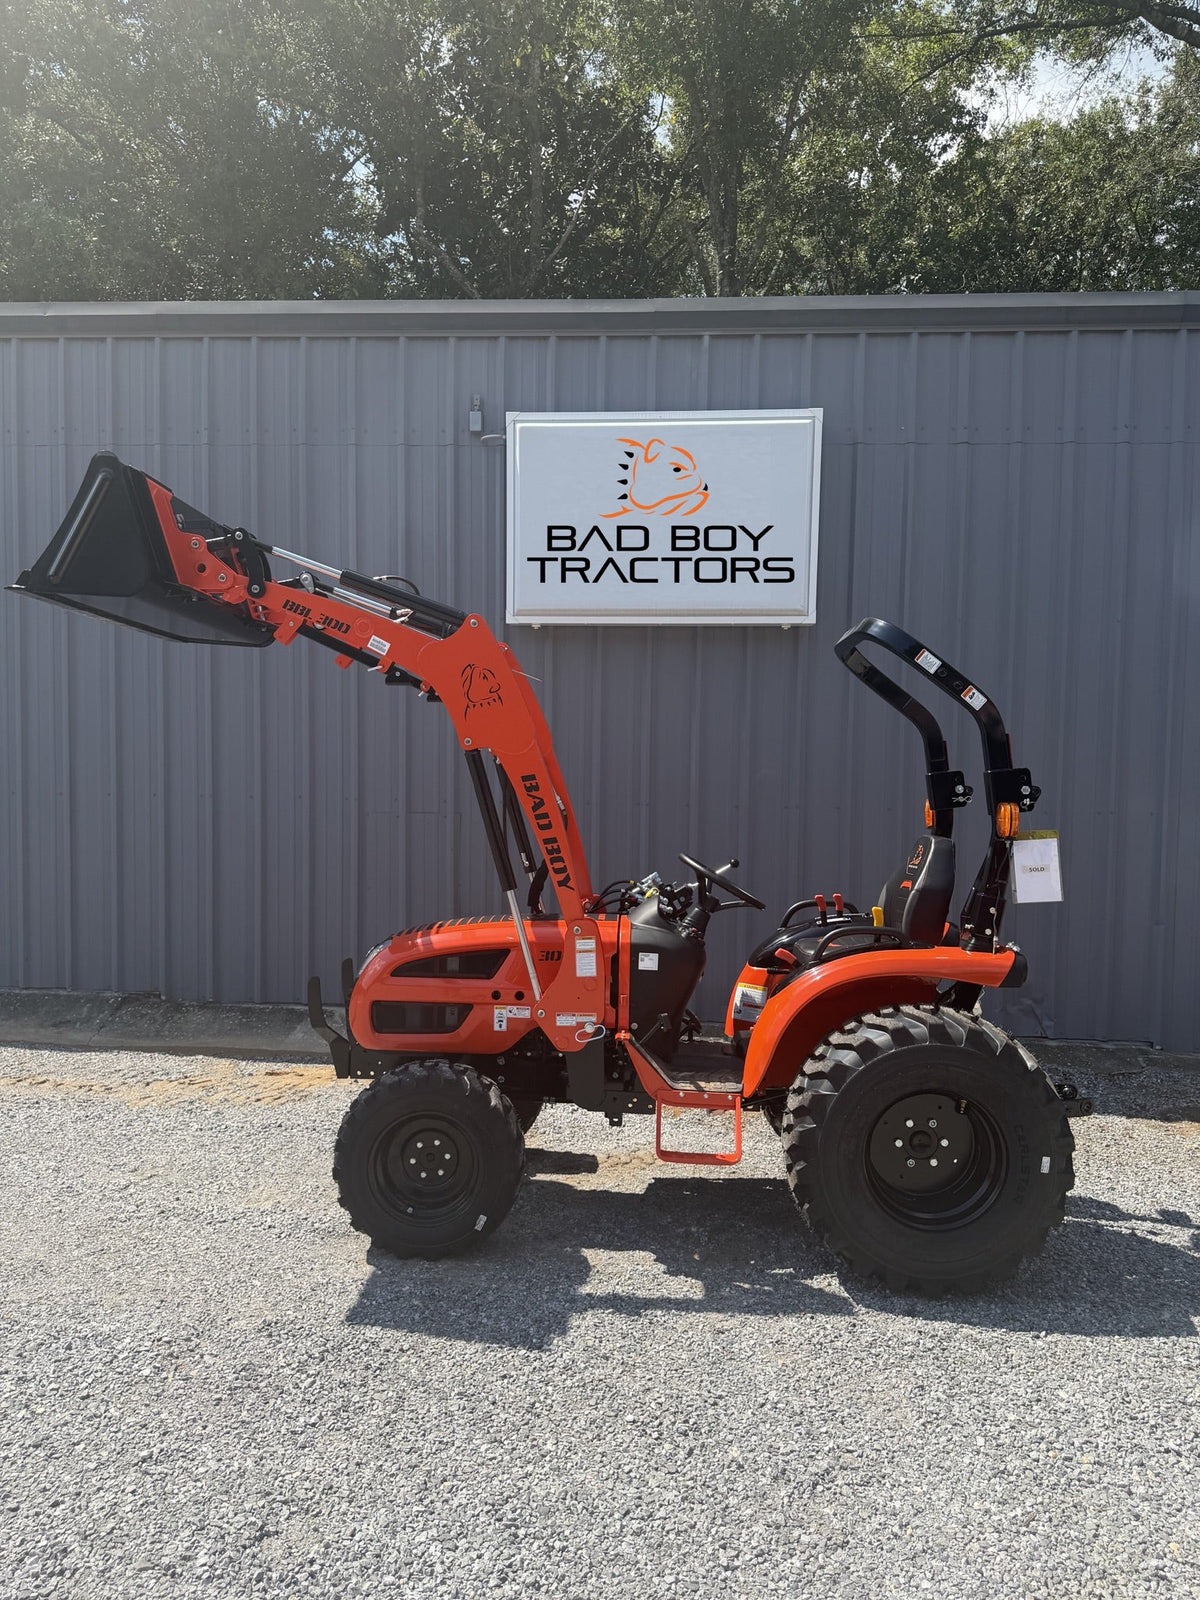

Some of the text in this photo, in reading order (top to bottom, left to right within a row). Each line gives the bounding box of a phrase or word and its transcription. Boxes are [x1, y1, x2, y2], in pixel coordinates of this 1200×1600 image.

[547, 525, 774, 552] BAD BOY
[526, 556, 795, 584] TRACTORS
[282, 599, 351, 634] BBL 300
[520, 774, 575, 891] BAD BOY
[538, 950, 563, 961] 30
